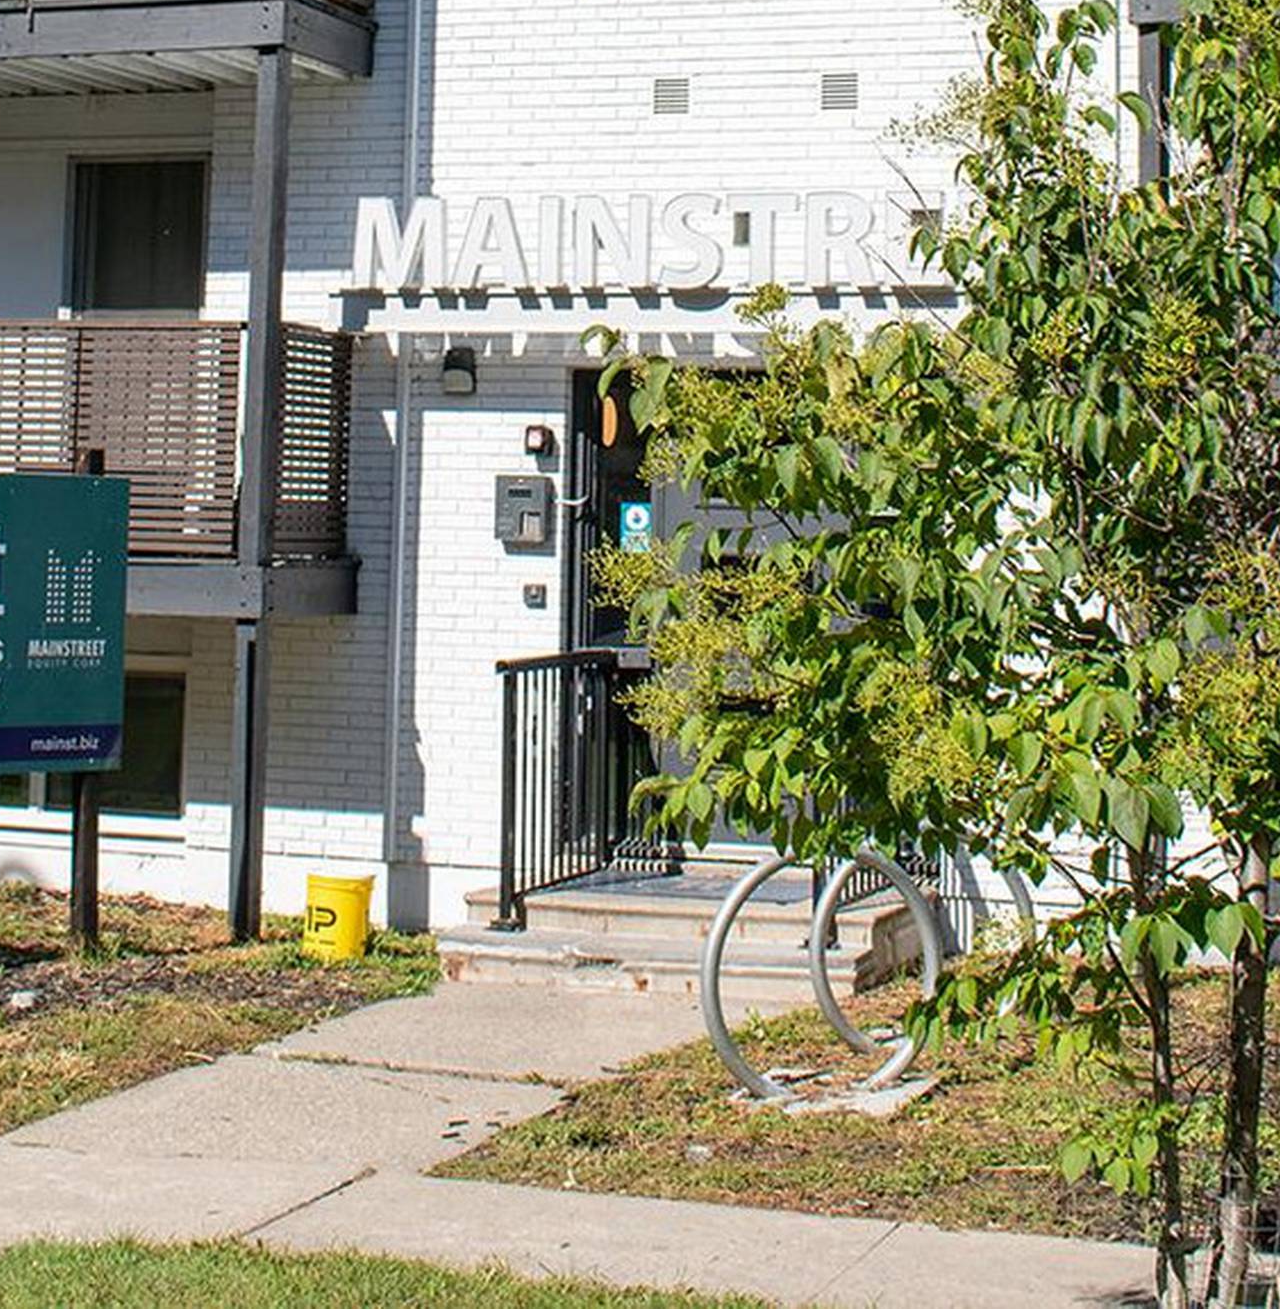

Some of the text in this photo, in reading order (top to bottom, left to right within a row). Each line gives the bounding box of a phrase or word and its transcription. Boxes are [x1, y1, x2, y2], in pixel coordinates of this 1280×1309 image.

[353, 191, 965, 288] MAINSTRE
[28, 639, 106, 657] MAINSTREET
[30, 734, 99, 752] mainst.biz
